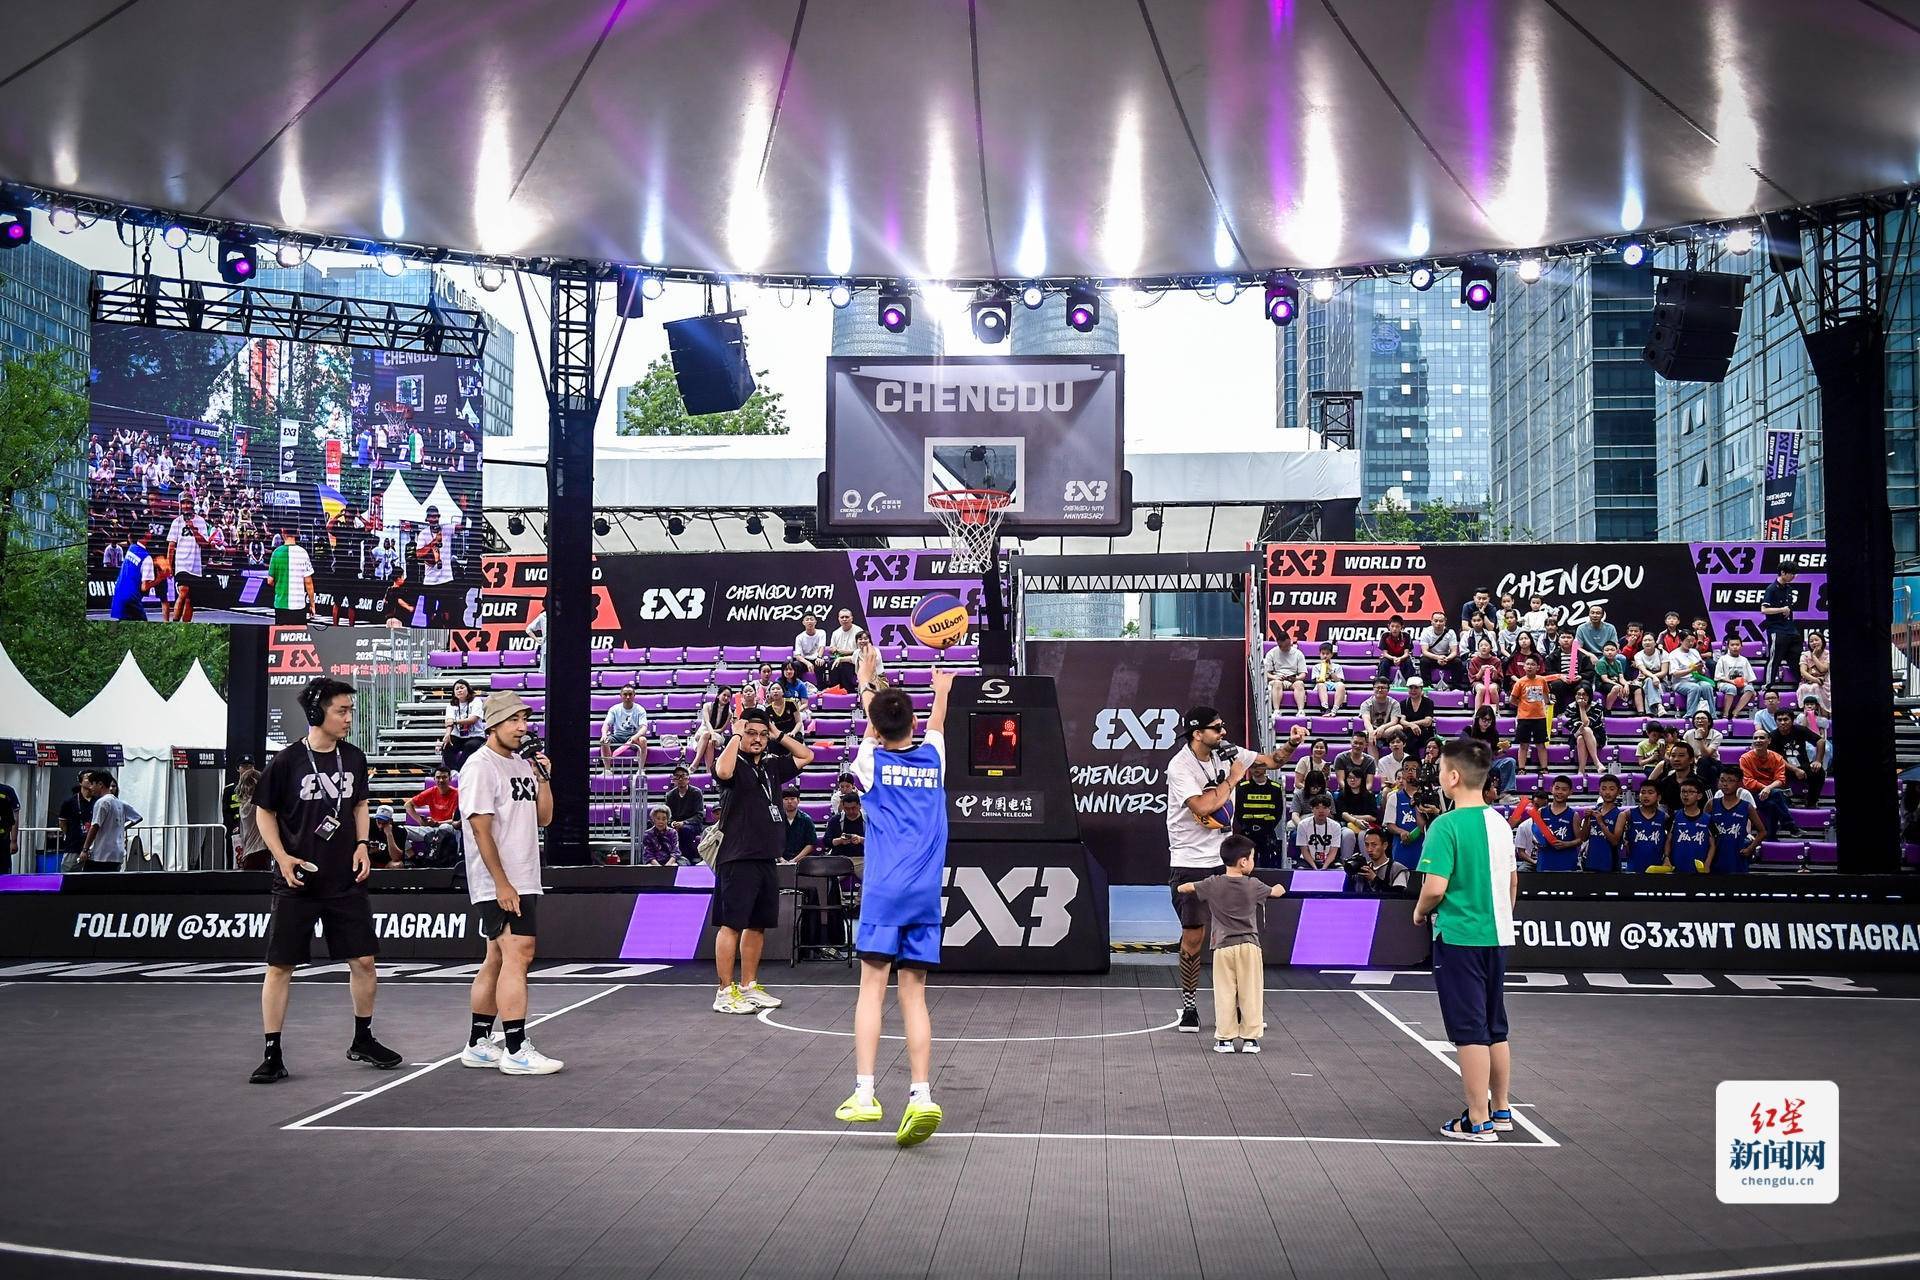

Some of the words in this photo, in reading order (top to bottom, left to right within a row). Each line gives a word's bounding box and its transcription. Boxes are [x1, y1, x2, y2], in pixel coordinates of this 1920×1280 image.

[876, 381, 1073, 412] CHENGDU
[931, 561, 945, 574] W
[1345, 556, 1401, 569] WORLD
[1406, 556, 1426, 569] TO
[1496, 563, 1644, 599] CHENGDU
[726, 584, 796, 600] CHENGDU
[800, 584, 834, 599] 10TH
[1289, 591, 1337, 605] TOUR
[1716, 590, 1732, 603] W
[482, 602, 517, 617] OUR
[873, 596, 887, 609] W
[929, 614, 964, 634] Wilson
[591, 636, 614, 649] UR
[270, 676, 307, 685] WORLD
[1070, 763, 1159, 787] CHENGDU
[982, 796, 1033, 811] 中国电信
[1074, 791, 1167, 814] NNIVERS
[74, 913, 173, 938] FOLLOW
[178, 913, 271, 940] @3x3W
[372, 913, 467, 938] TAGRAM
[1513, 920, 1611, 947] FOLLOW
[1620, 922, 1736, 950] @3x3WT
[1745, 922, 1780, 949] ON
[1788, 923, 1920, 951] INSTAGRA
